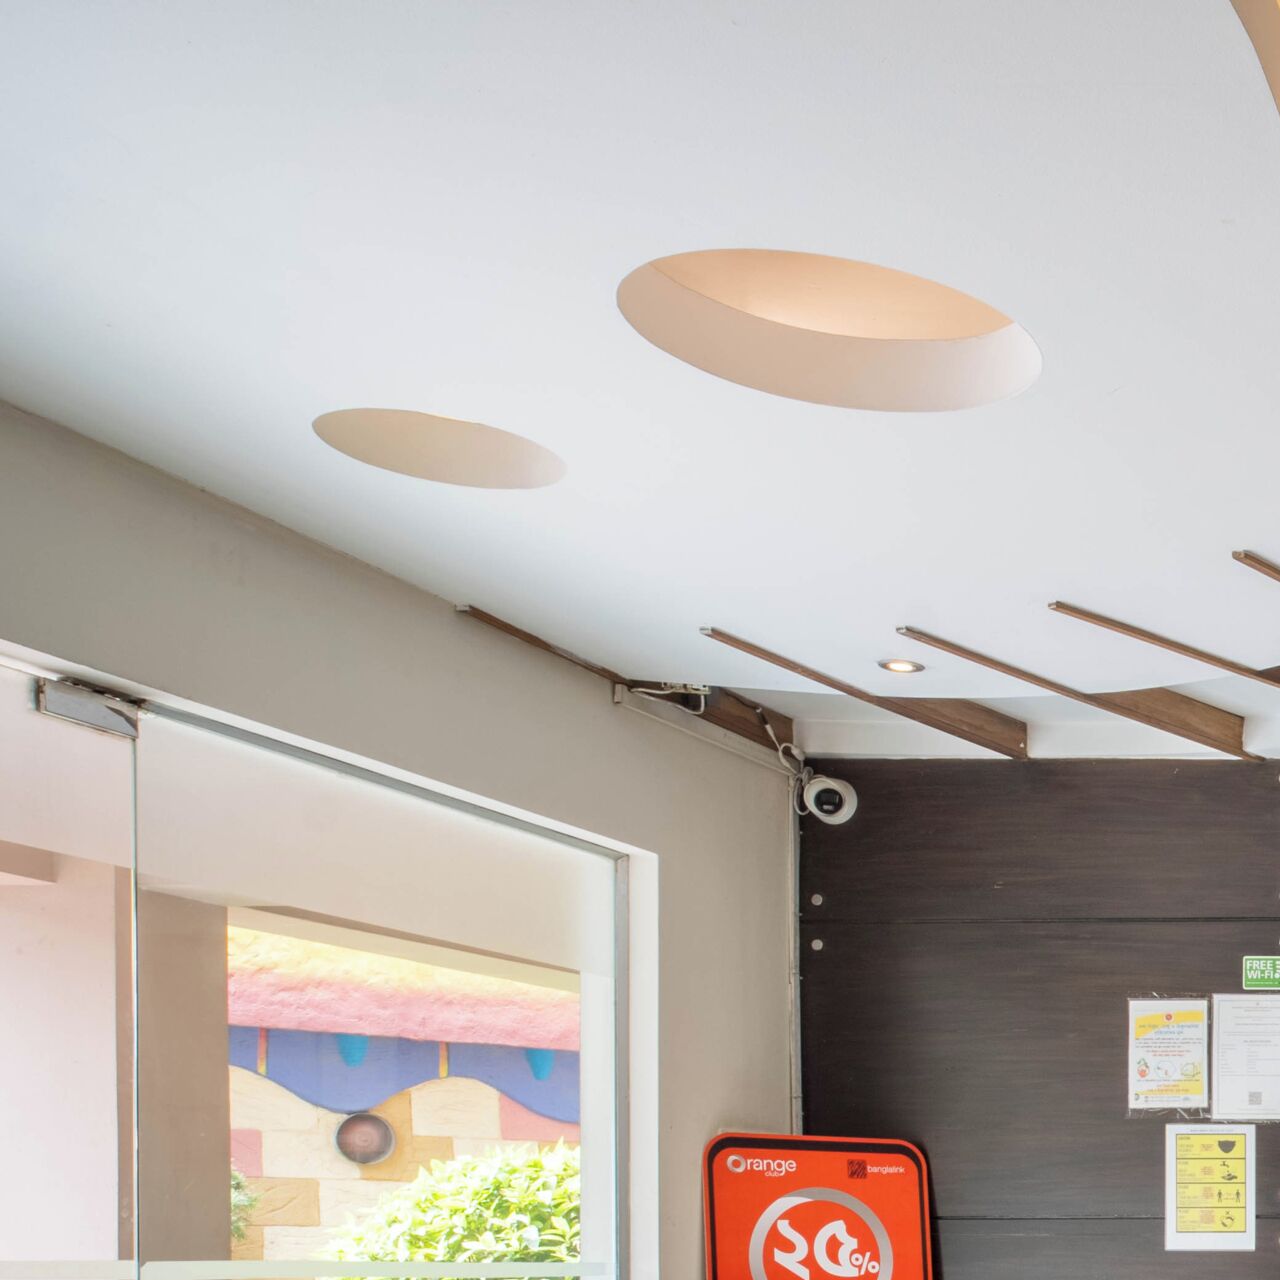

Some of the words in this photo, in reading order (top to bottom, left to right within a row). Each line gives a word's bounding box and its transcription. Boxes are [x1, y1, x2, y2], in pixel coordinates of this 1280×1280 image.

[1246, 960, 1274, 970] FREE
[1246, 970, 1274, 979] WI-FI
[726, 1154, 797, 1177] Orange
[867, 1164, 906, 1175] banglalink
